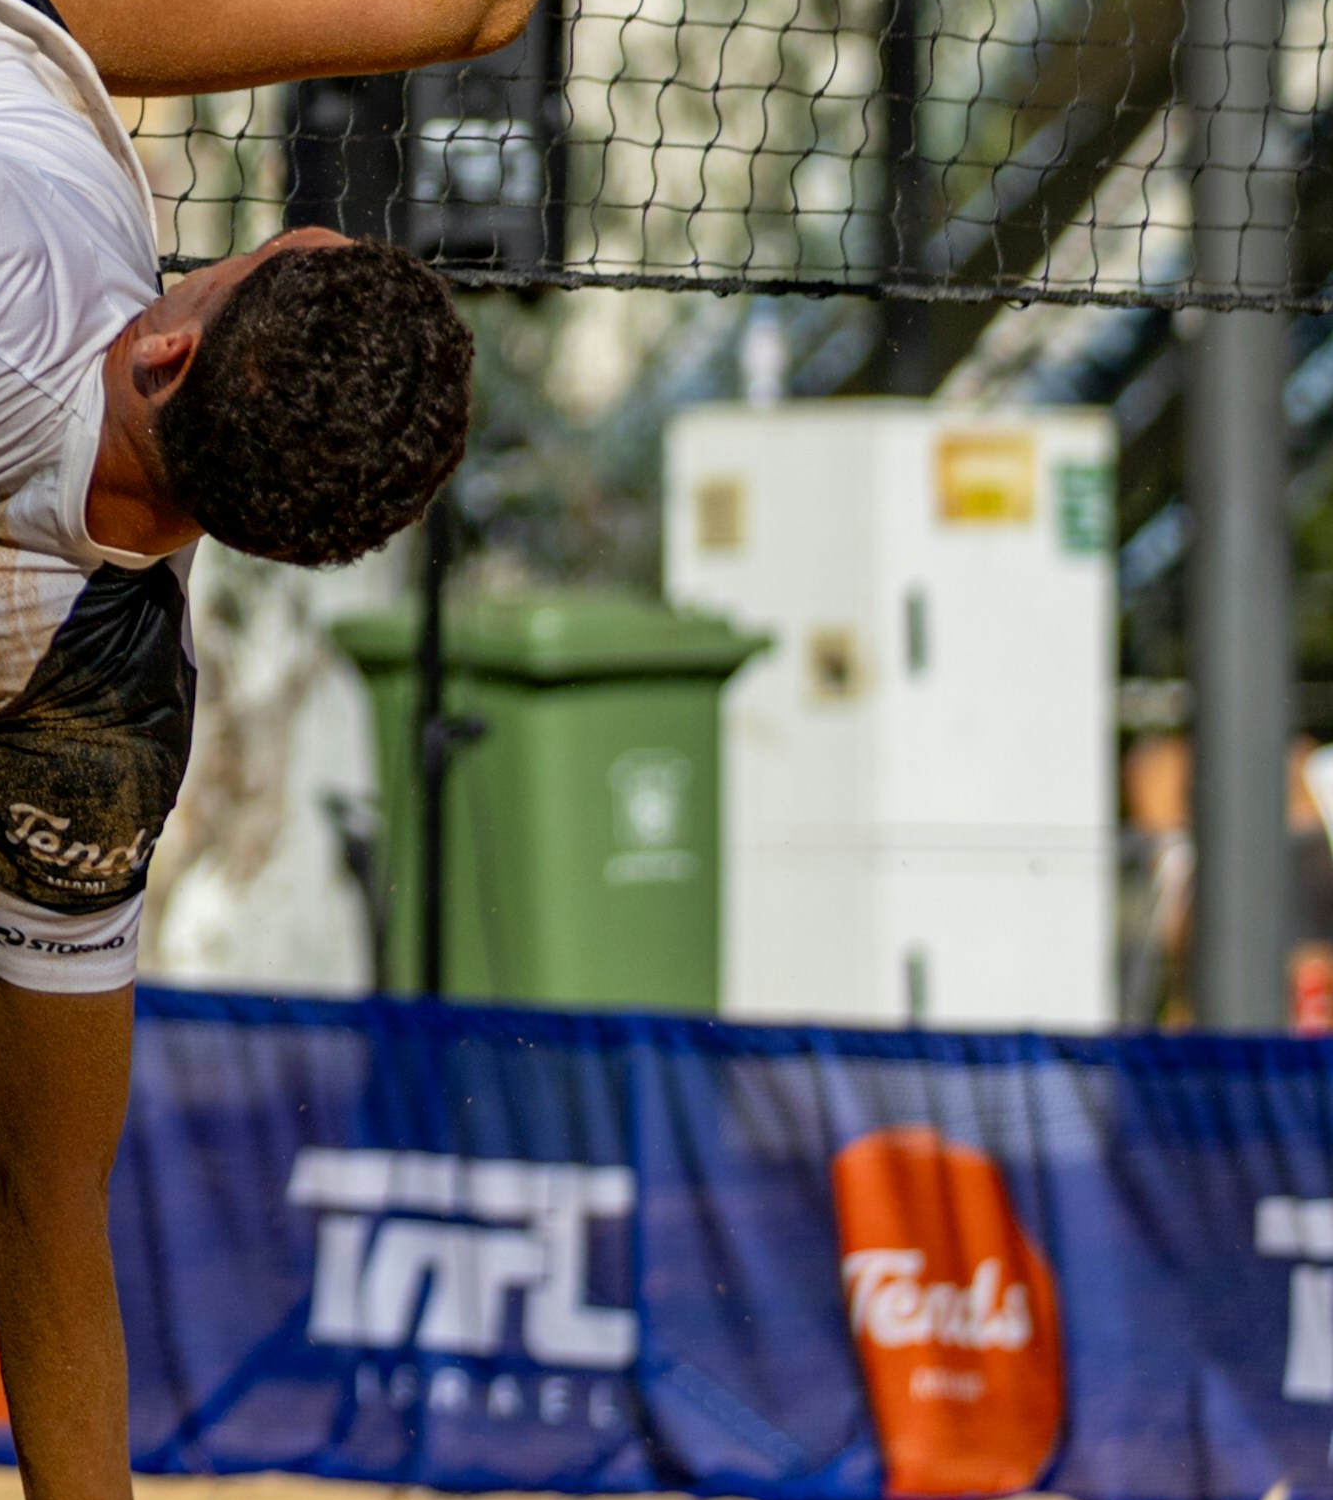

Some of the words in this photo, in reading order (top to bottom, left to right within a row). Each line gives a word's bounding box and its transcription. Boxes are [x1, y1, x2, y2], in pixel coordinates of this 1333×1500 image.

[5, 802, 159, 875] Tend
[48, 875, 106, 893] MIAMI
[27, 936, 125, 954] STORMO
